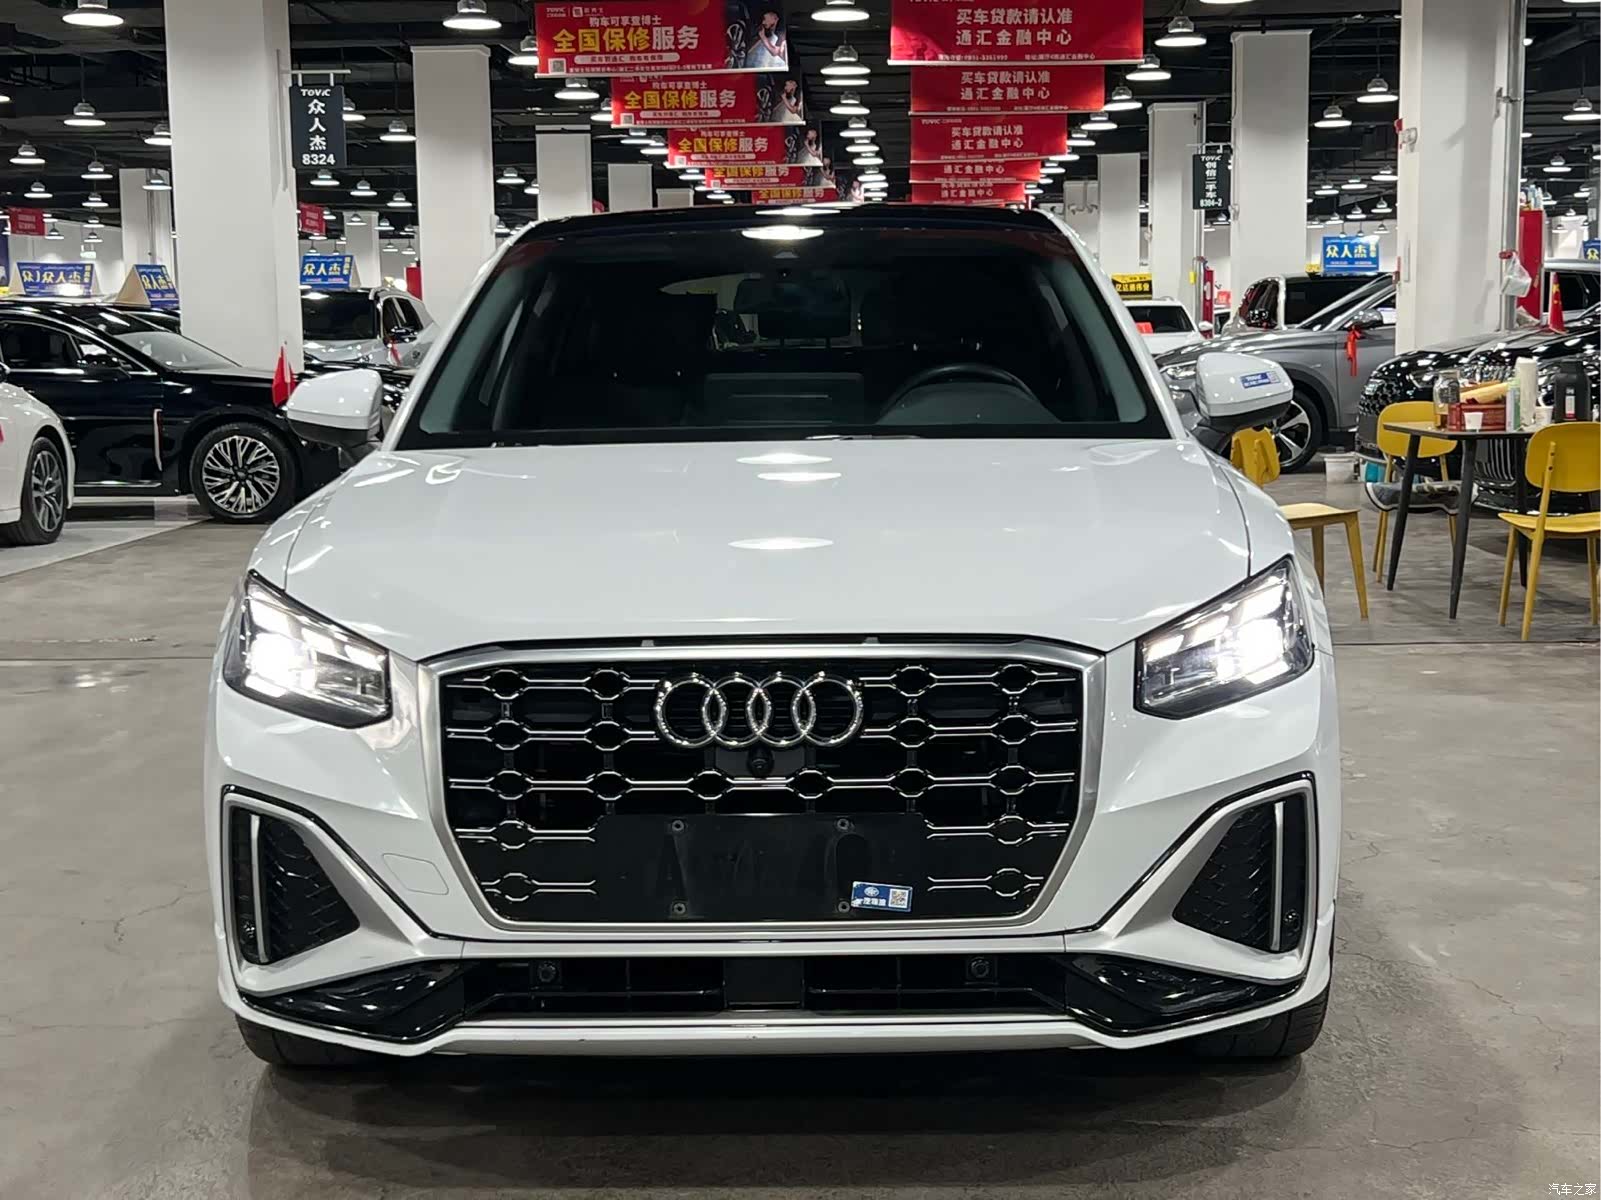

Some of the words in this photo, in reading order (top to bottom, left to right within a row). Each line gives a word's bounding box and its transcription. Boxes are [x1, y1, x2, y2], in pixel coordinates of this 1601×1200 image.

[589, 15, 662, 27] 购车可享查博士
[956, 8, 1073, 25] 买车贷款请认准
[552, 25, 700, 53] 全国保修服务
[956, 28, 1072, 46] 通汇金融中心
[961, 71, 1050, 84] 买车贷款请认准
[624, 89, 737, 110] 全国保修服务
[960, 87, 1050, 100] 通汇金融中心
[308, 98, 326, 151] 众人杰
[951, 125, 1024, 137] 买车贷款请认准
[678, 136, 769, 153] 全国保修服务
[951, 138, 1024, 150] 通汇金融中心
[302, 154, 335, 165] 8324
[1326, 245, 1367, 258] 众人杰
